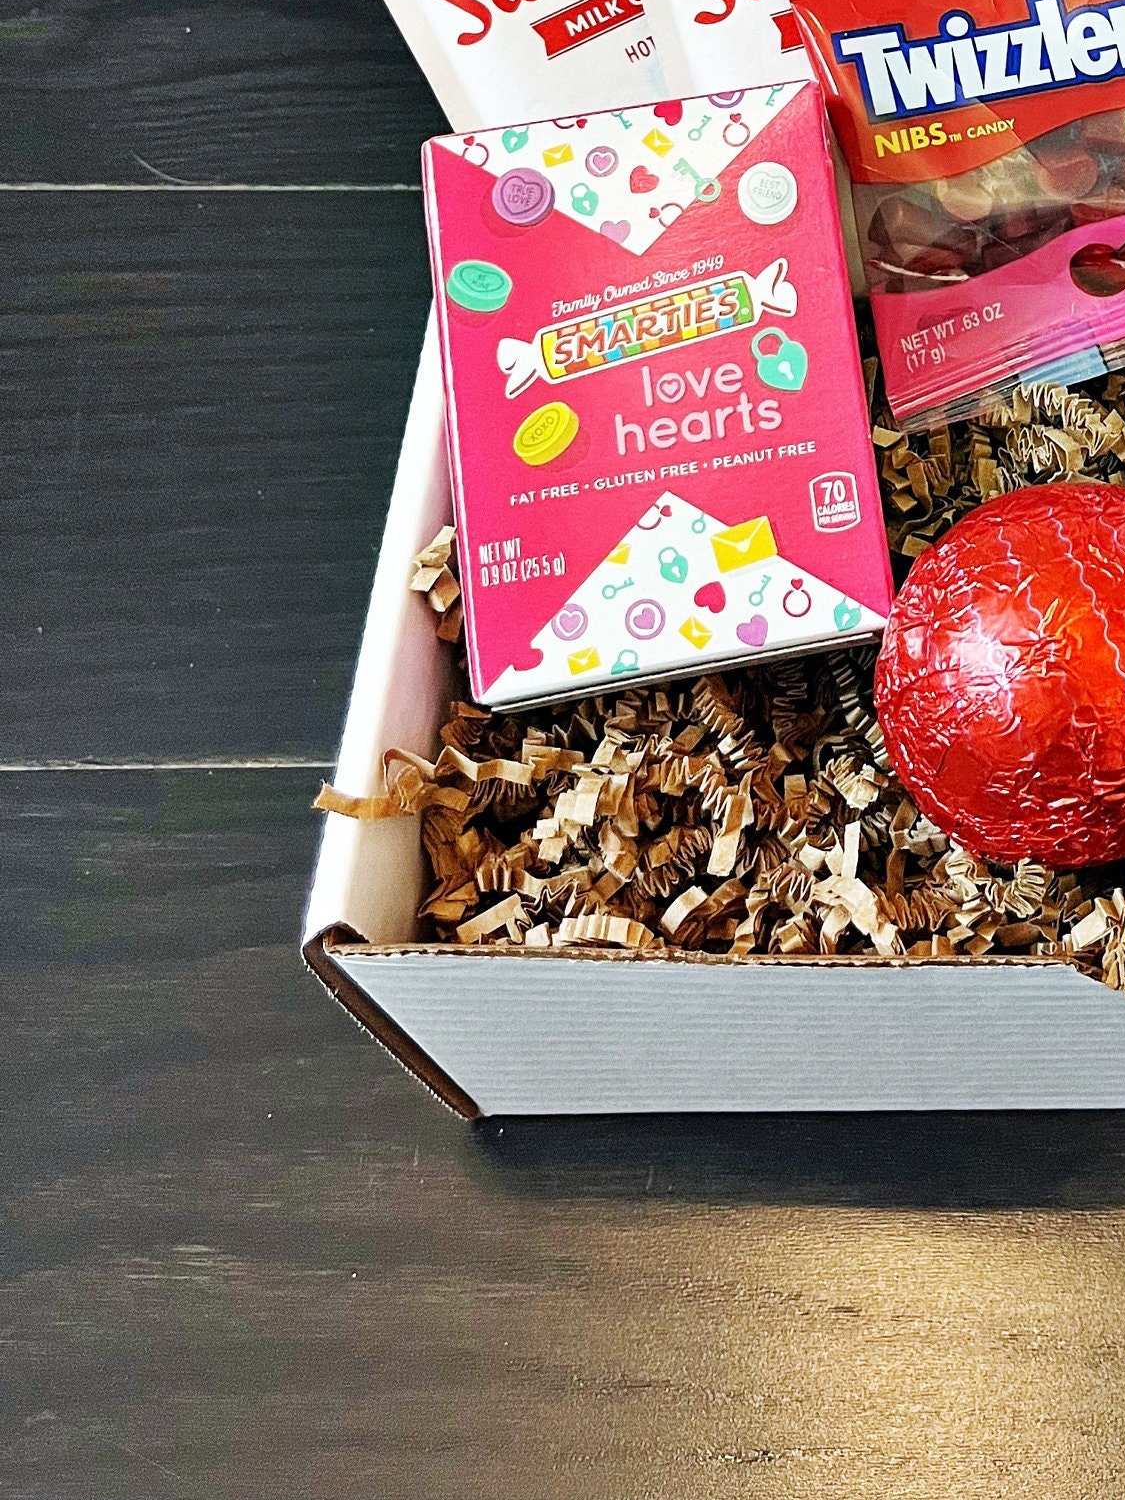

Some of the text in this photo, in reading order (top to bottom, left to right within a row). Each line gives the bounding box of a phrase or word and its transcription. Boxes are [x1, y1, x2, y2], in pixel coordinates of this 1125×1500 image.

[624, 35, 657, 64] HOT
[966, 118, 1016, 139] CANDY
[507, 193, 533, 207] LOVE
[510, 183, 535, 197] TRUE
[552, 254, 725, 318] Family Owned Since 1949
[553, 288, 740, 366] SMARTIES
[900, 302, 1005, 354] NET WT .63 OZ
[906, 343, 947, 374] (17 g)
[641, 363, 744, 407] love
[529, 415, 555, 442] XOXO
[614, 392, 783, 456] hearts
[510, 440, 817, 507] FAT FREE GLUTEN FREE PEANUT FREE
[820, 479, 846, 505] 70
[479, 537, 521, 565] NET WT
[481, 564, 500, 587] 0.9
[502, 561, 519, 583] OZ
[521, 554, 551, 582] (255
